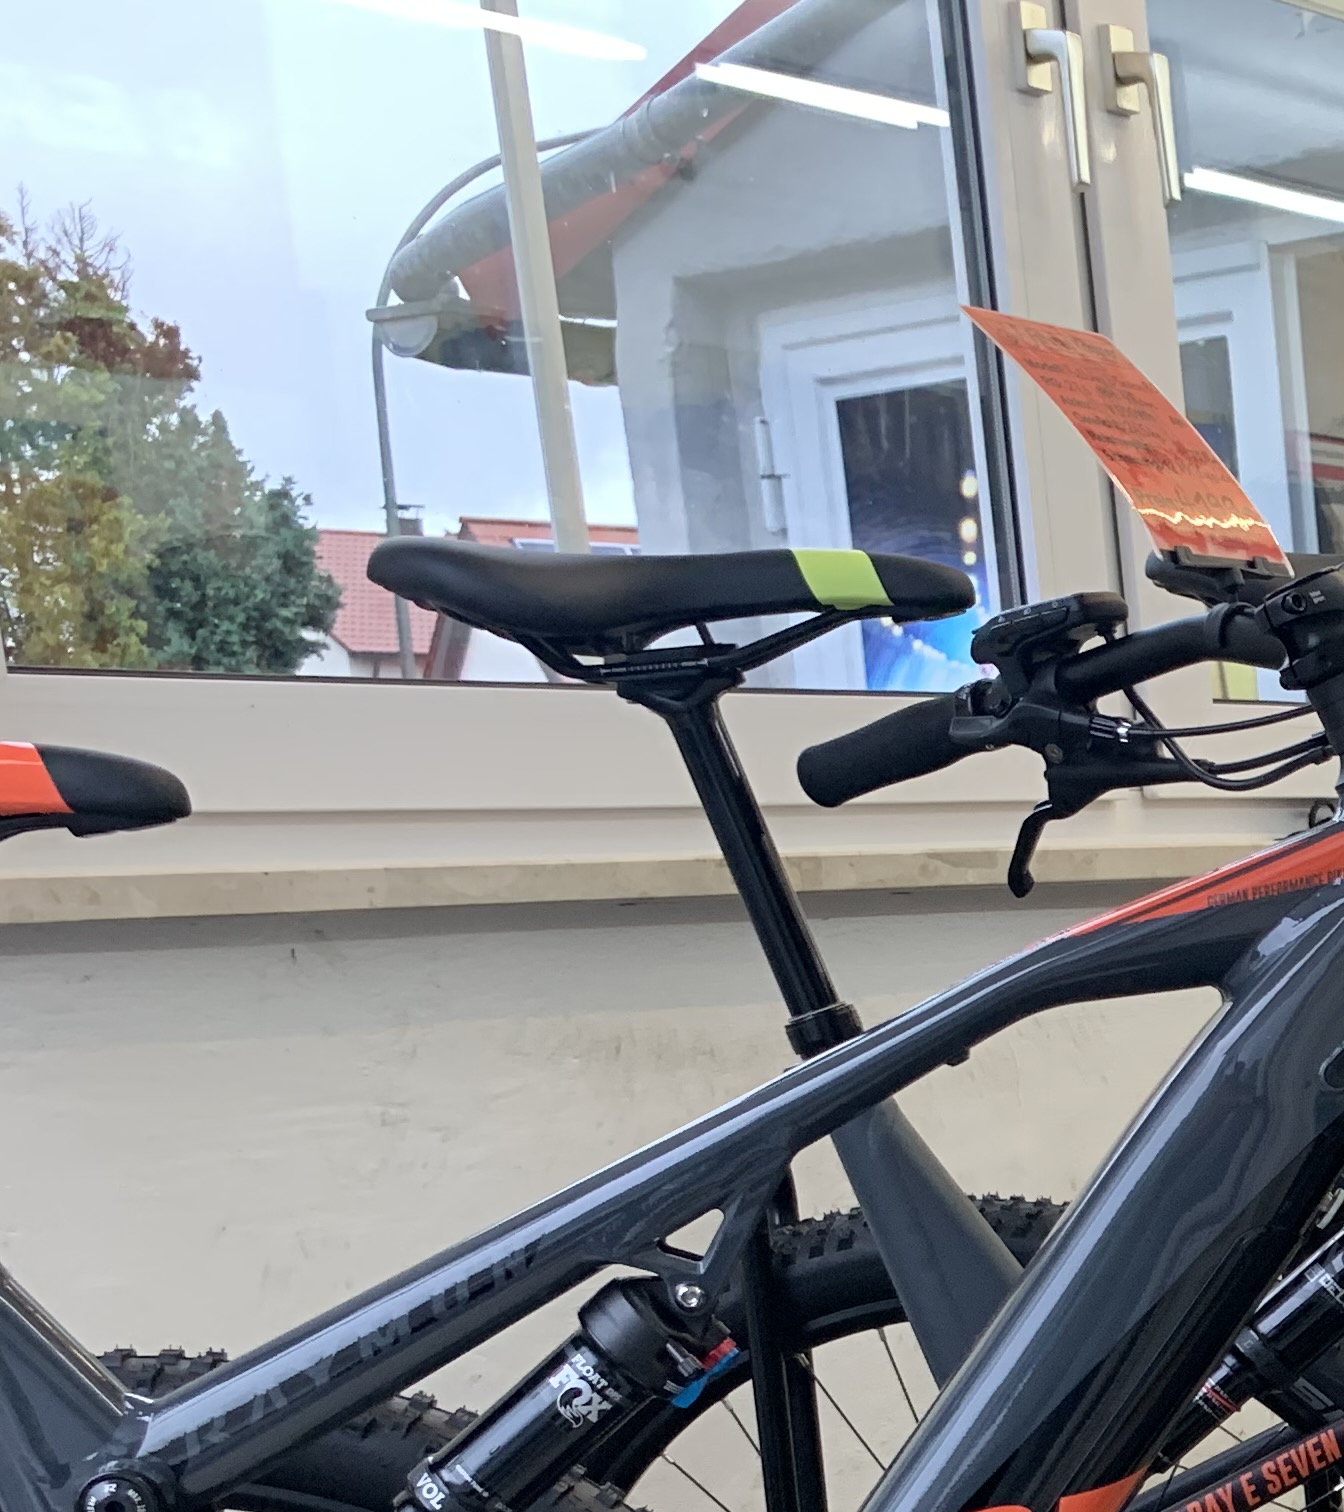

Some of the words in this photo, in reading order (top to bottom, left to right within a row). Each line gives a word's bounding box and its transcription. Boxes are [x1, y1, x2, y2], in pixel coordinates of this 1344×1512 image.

[549, 1363, 613, 1428] FOX
[571, 1353, 608, 1390] FLOAT
[415, 1472, 444, 1511] VOL
[1240, 1470, 1262, 1507] E
[1260, 1427, 1342, 1495] SEVEN
